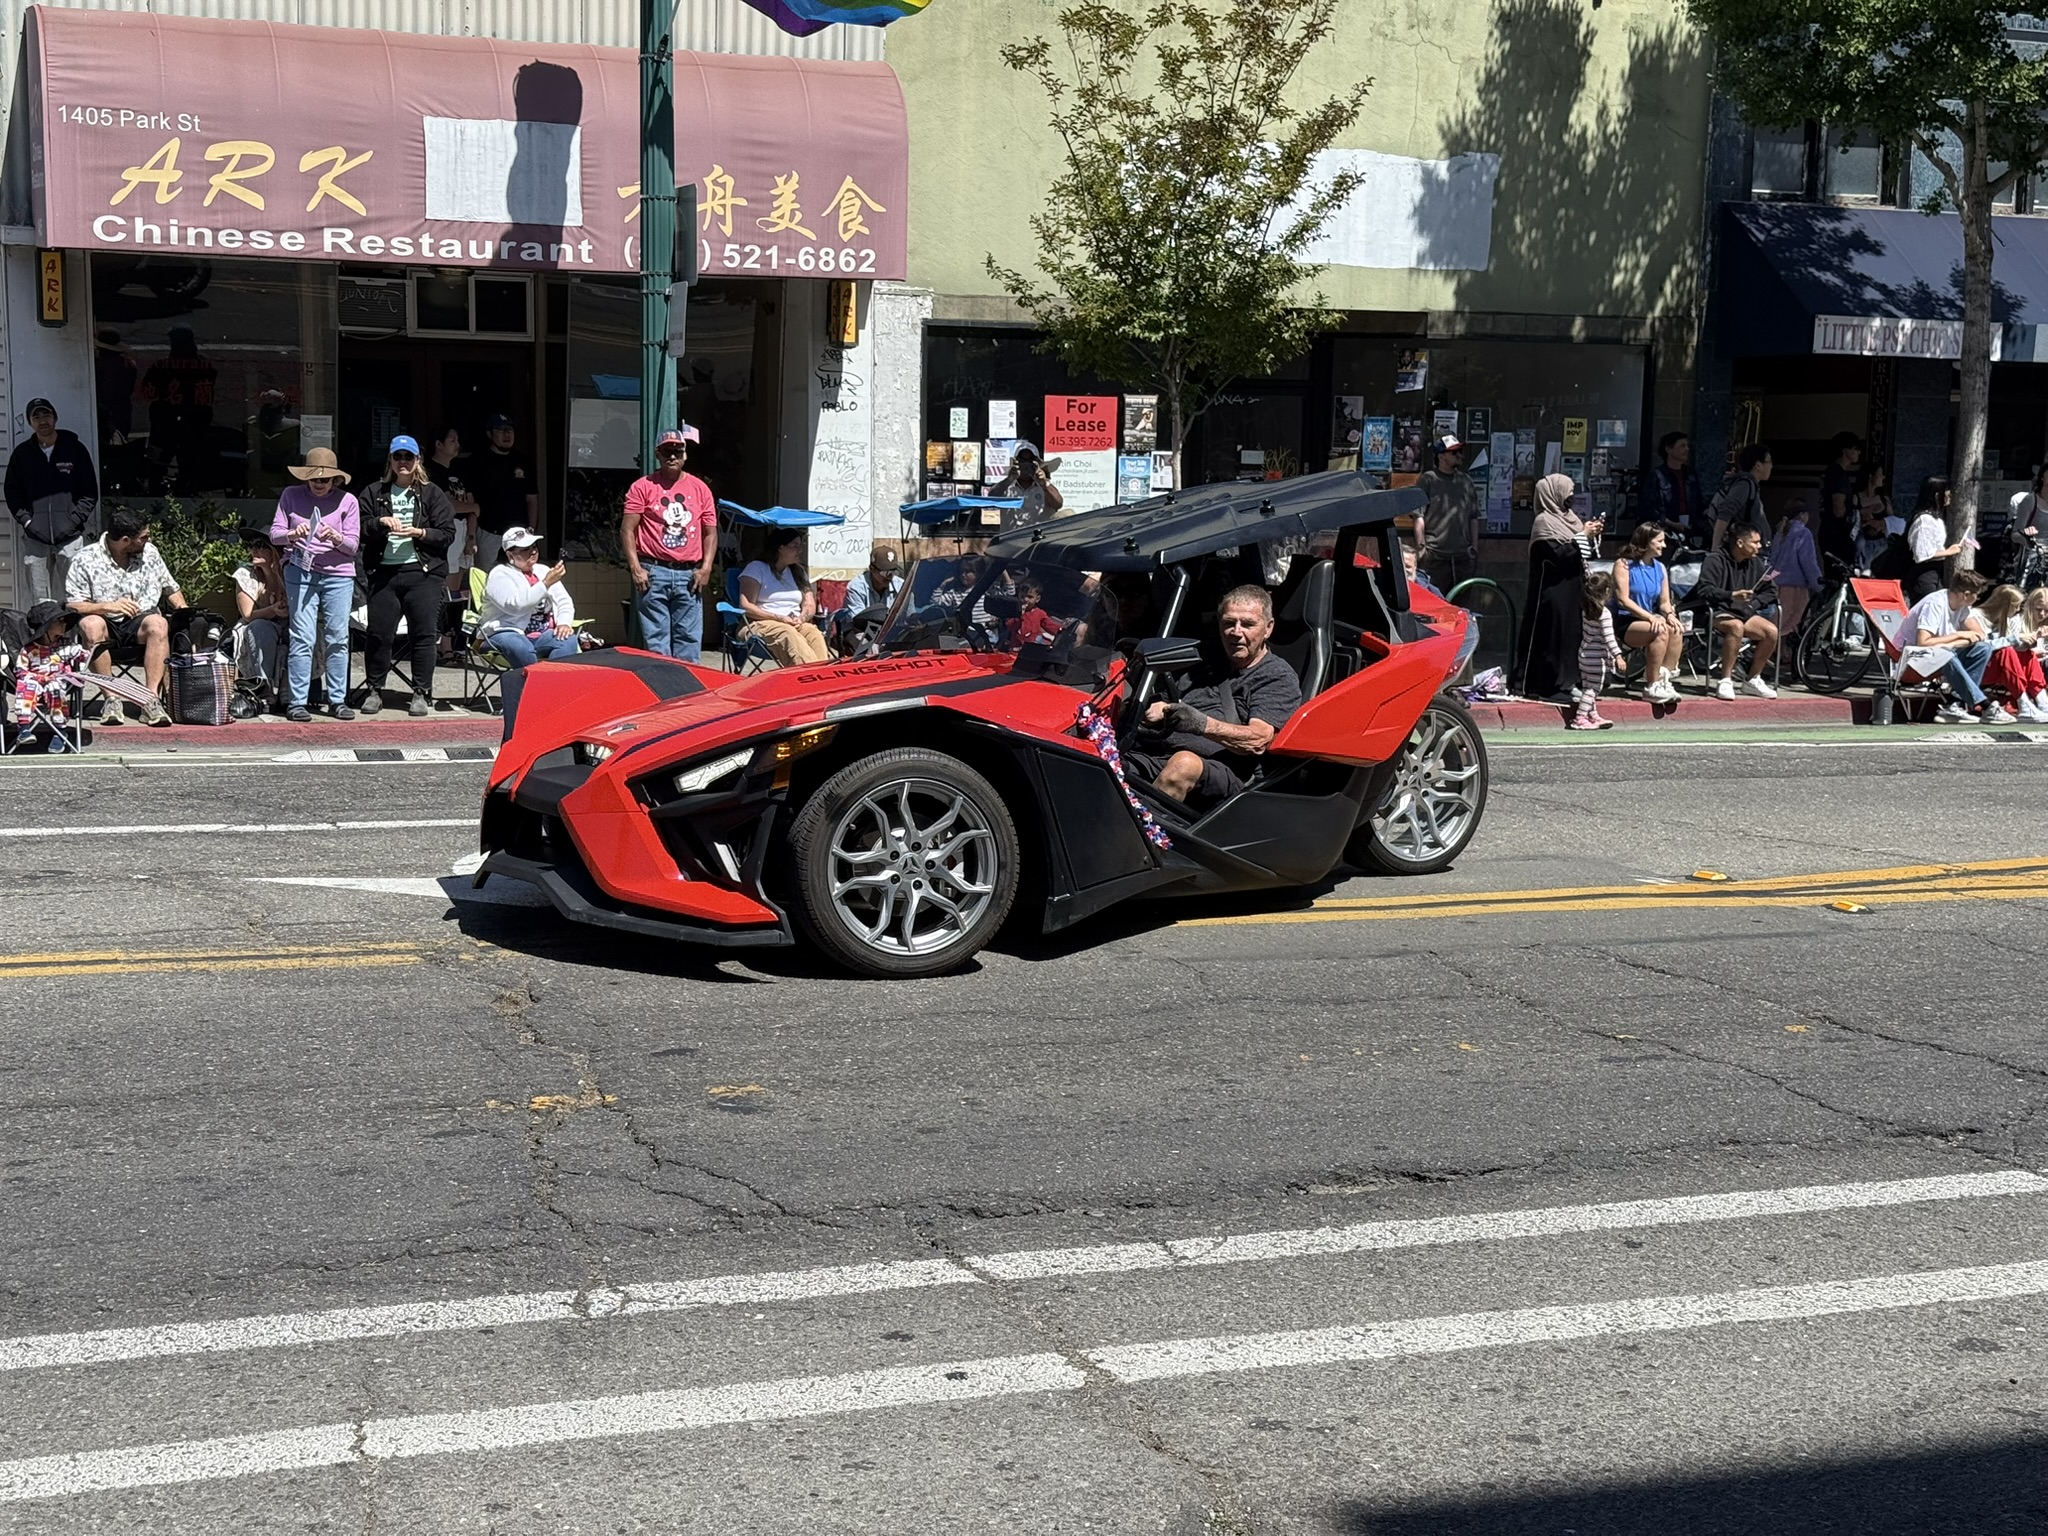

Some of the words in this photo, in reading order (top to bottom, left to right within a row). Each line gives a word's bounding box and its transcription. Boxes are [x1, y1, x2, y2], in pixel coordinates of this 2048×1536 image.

[58, 105, 113, 127] 1405
[120, 109, 171, 131] Park
[178, 112, 201, 133] St
[109, 137, 374, 217] ARK
[92, 214, 306, 252] Chinese
[323, 227, 594, 265] Restaurant
[722, 243, 877, 273] 521-6862
[45, 258, 60, 312] ARK
[841, 287, 853, 336] ARK
[1821, 321, 1878, 352] LITTLE
[1066, 398, 1097, 414] For
[1056, 416, 1106, 432] Lease
[1566, 421, 1584, 429] IMP
[1049, 436, 1113, 448] 415.395.7262
[1073, 460, 1092, 468] Choi
[1063, 480, 1106, 488] Badstubner
[797, 658, 948, 684] SLINGSHOT
